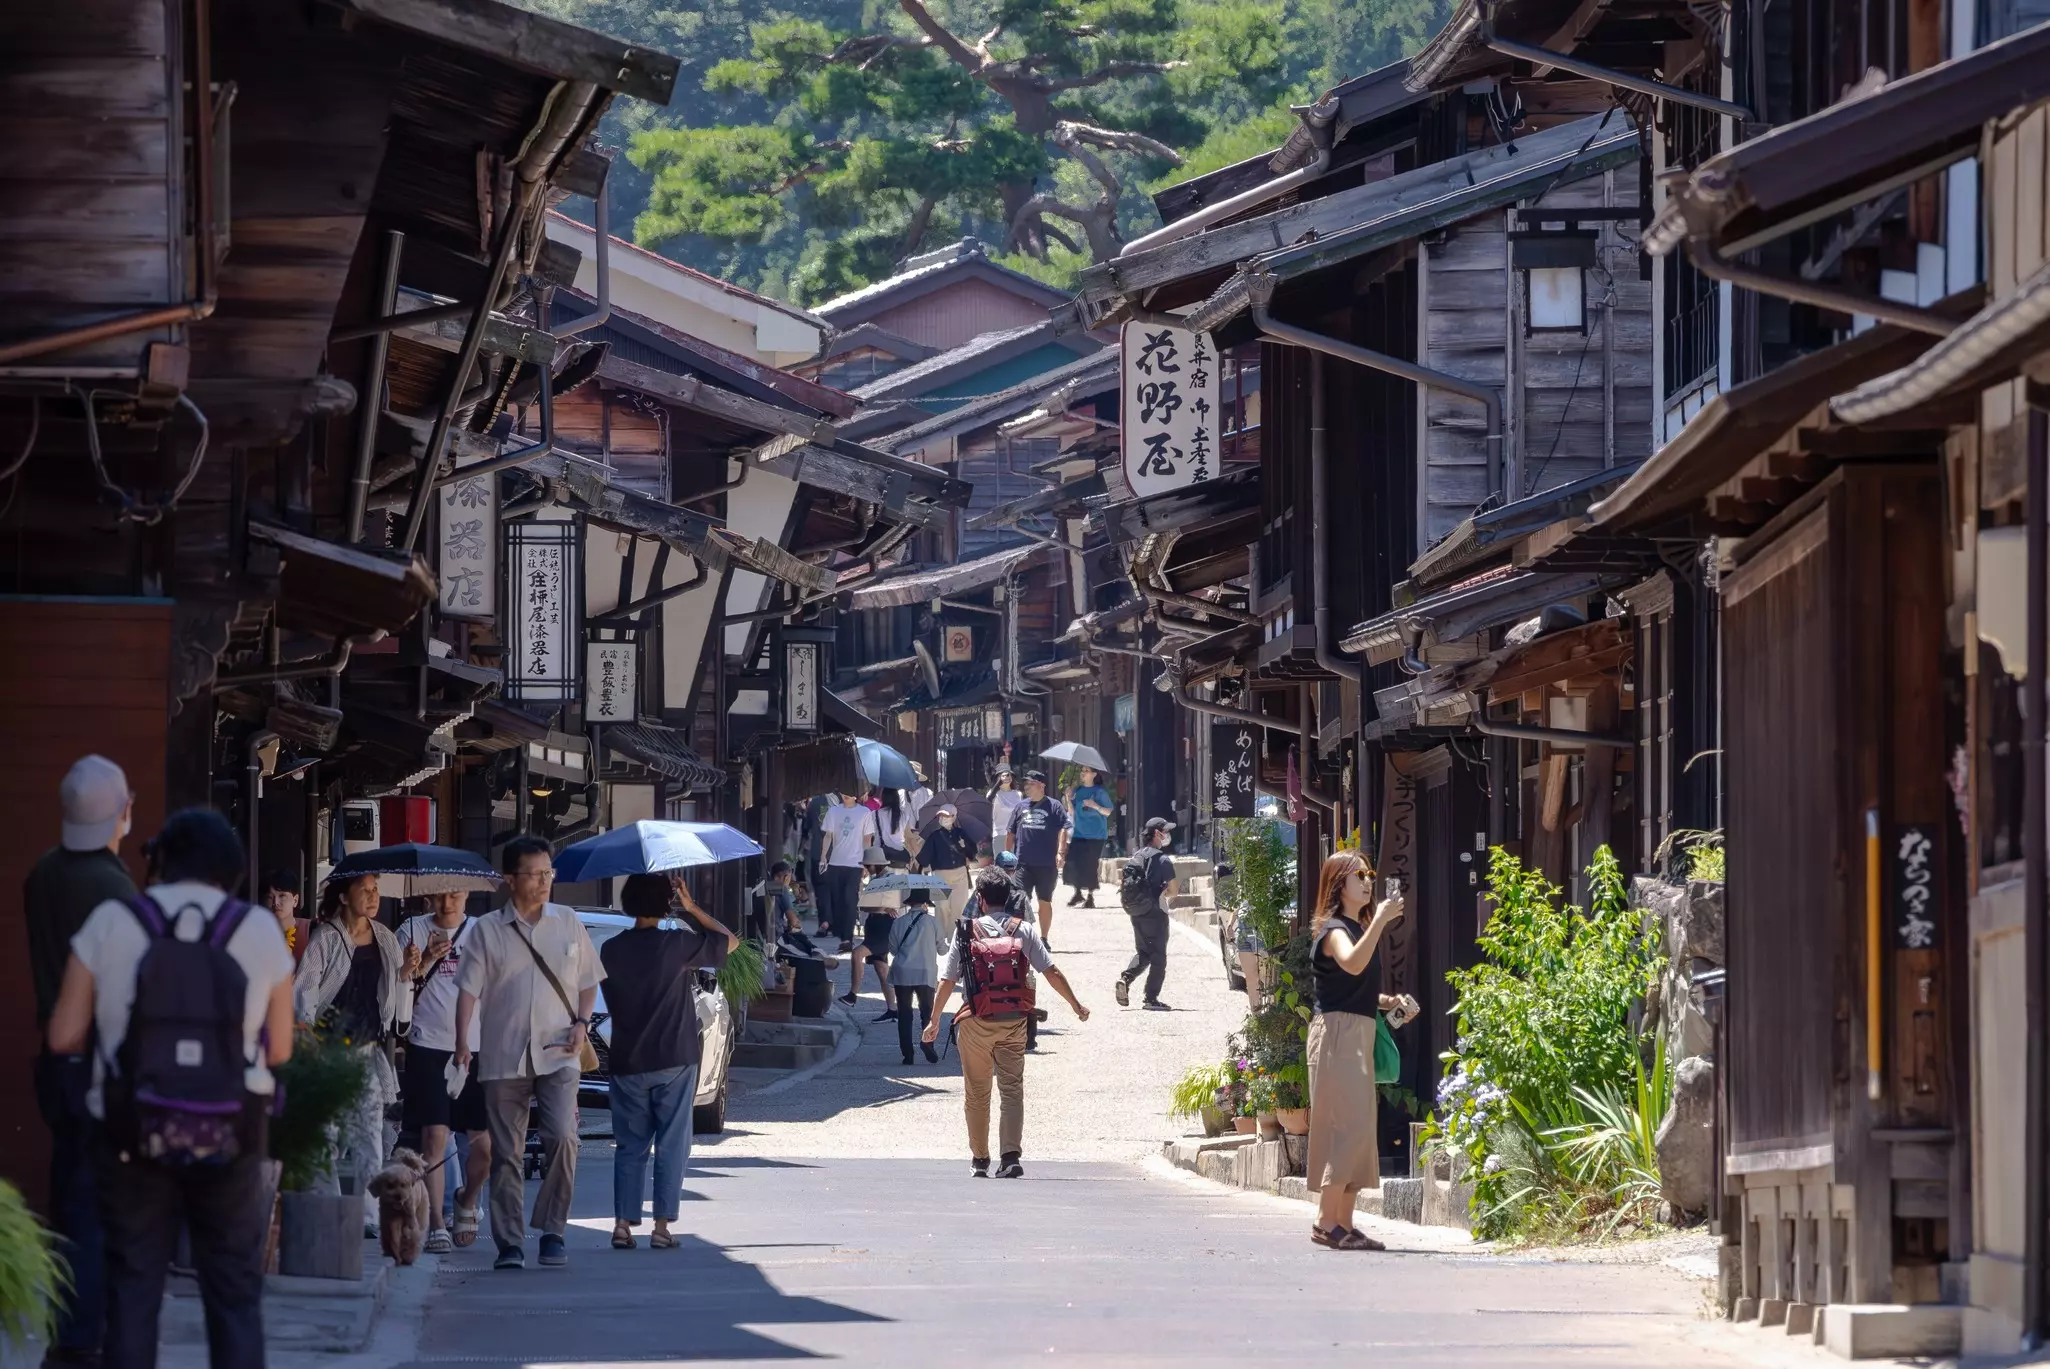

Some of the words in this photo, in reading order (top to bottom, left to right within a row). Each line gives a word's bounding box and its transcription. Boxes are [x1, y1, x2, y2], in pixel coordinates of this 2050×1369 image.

[1135, 329, 1183, 477] 花野屋
[444, 476, 491, 607] 漆器店
[1213, 768, 1233, 812] 漆の器
[1227, 760, 1237, 774] &
